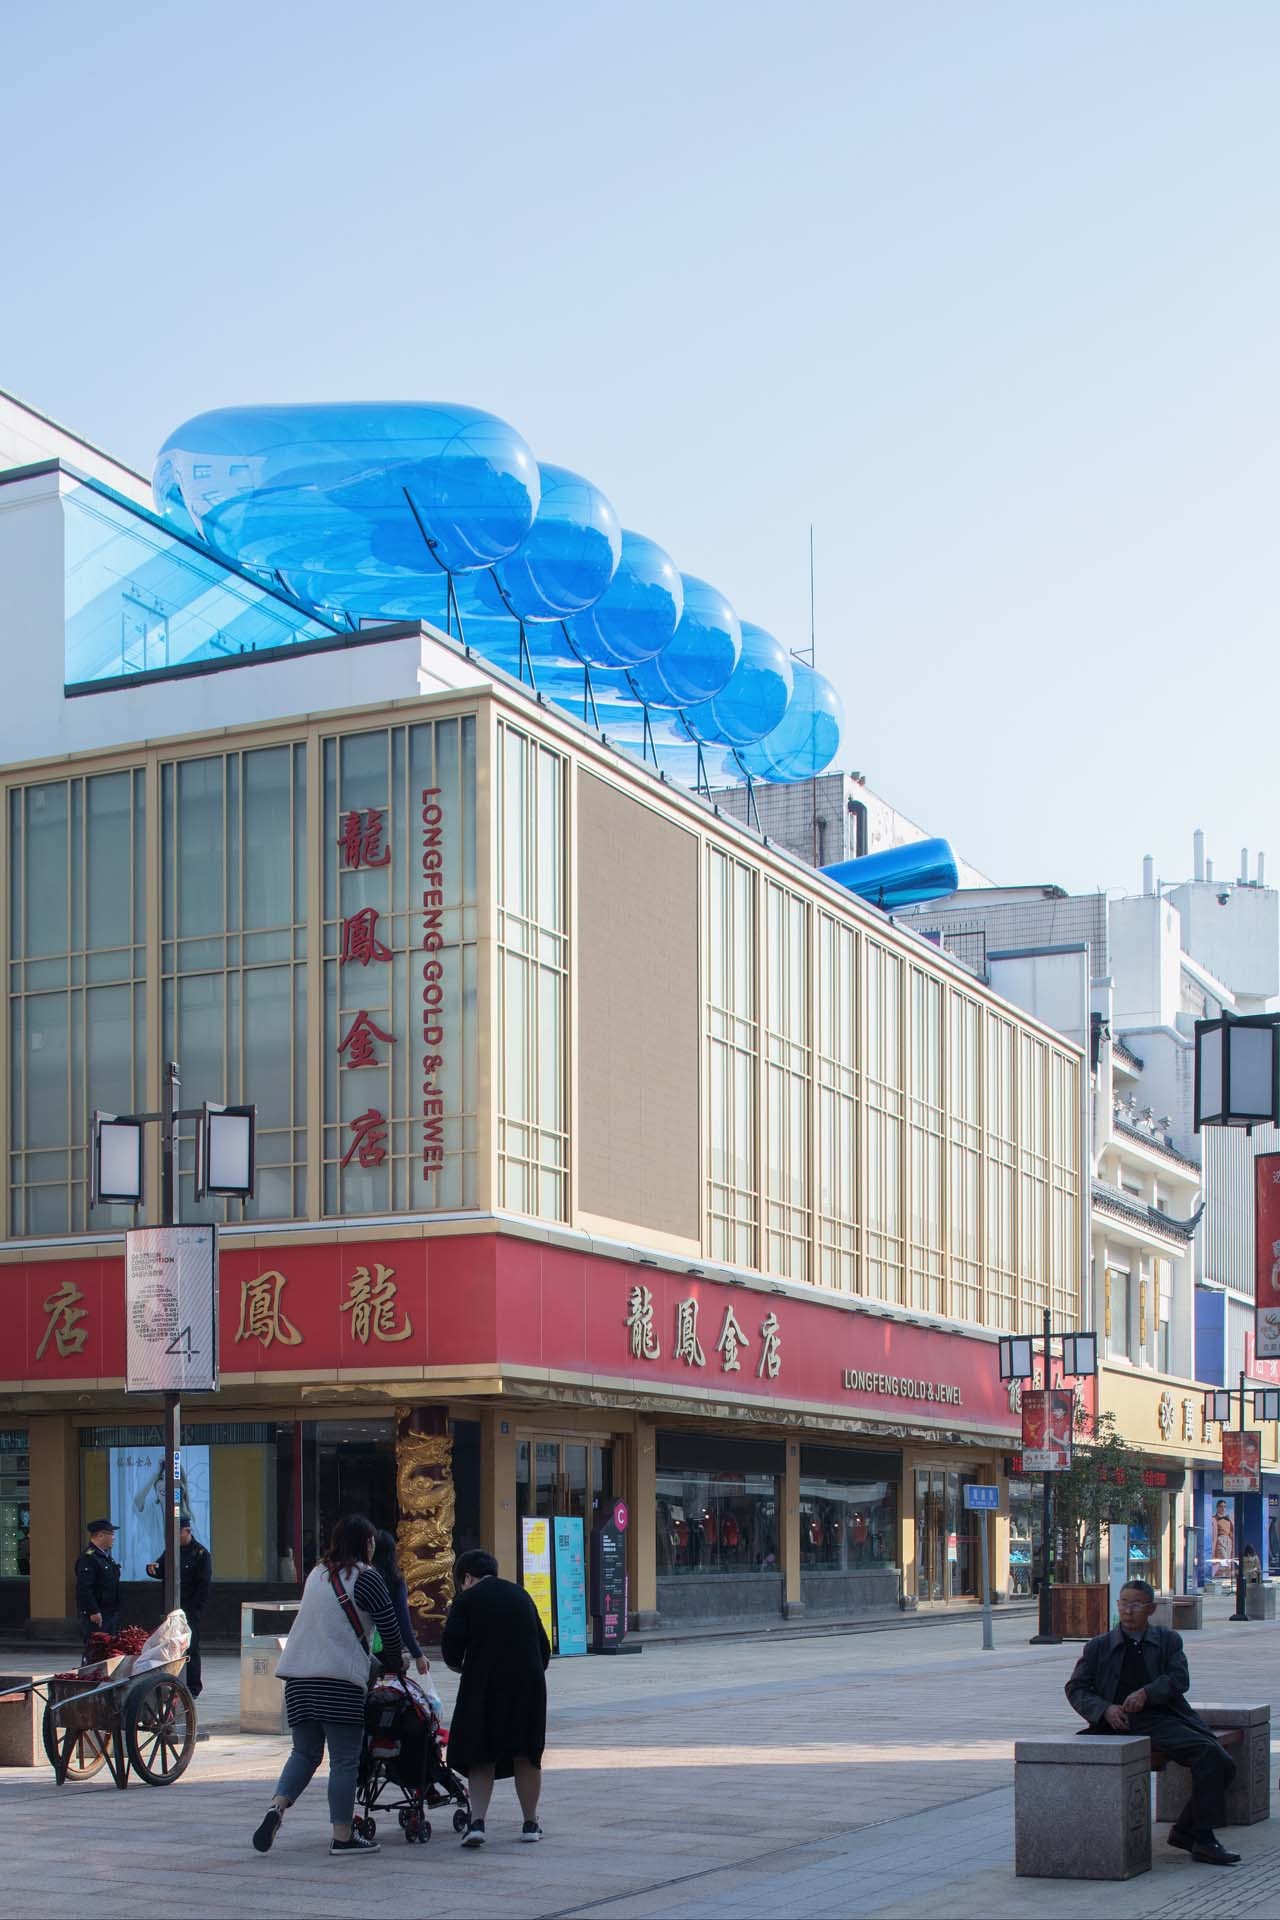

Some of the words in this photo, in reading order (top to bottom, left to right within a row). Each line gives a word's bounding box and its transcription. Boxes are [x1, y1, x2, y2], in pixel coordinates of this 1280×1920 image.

[421, 787, 444, 952] LONGFENG
[336, 806, 398, 1170] 龍鳳金店
[421, 959, 444, 1046] GOLD
[421, 1055, 444, 1075] &
[421, 1081, 444, 1182] JEWEL
[625, 1284, 783, 1380] 龍鳳金店
[843, 1367, 899, 1397] LONGFENG
[900, 1378, 926, 1399] GOLD
[927, 1381, 934, 1401] &
[934, 1383, 963, 1405] JEWEL
